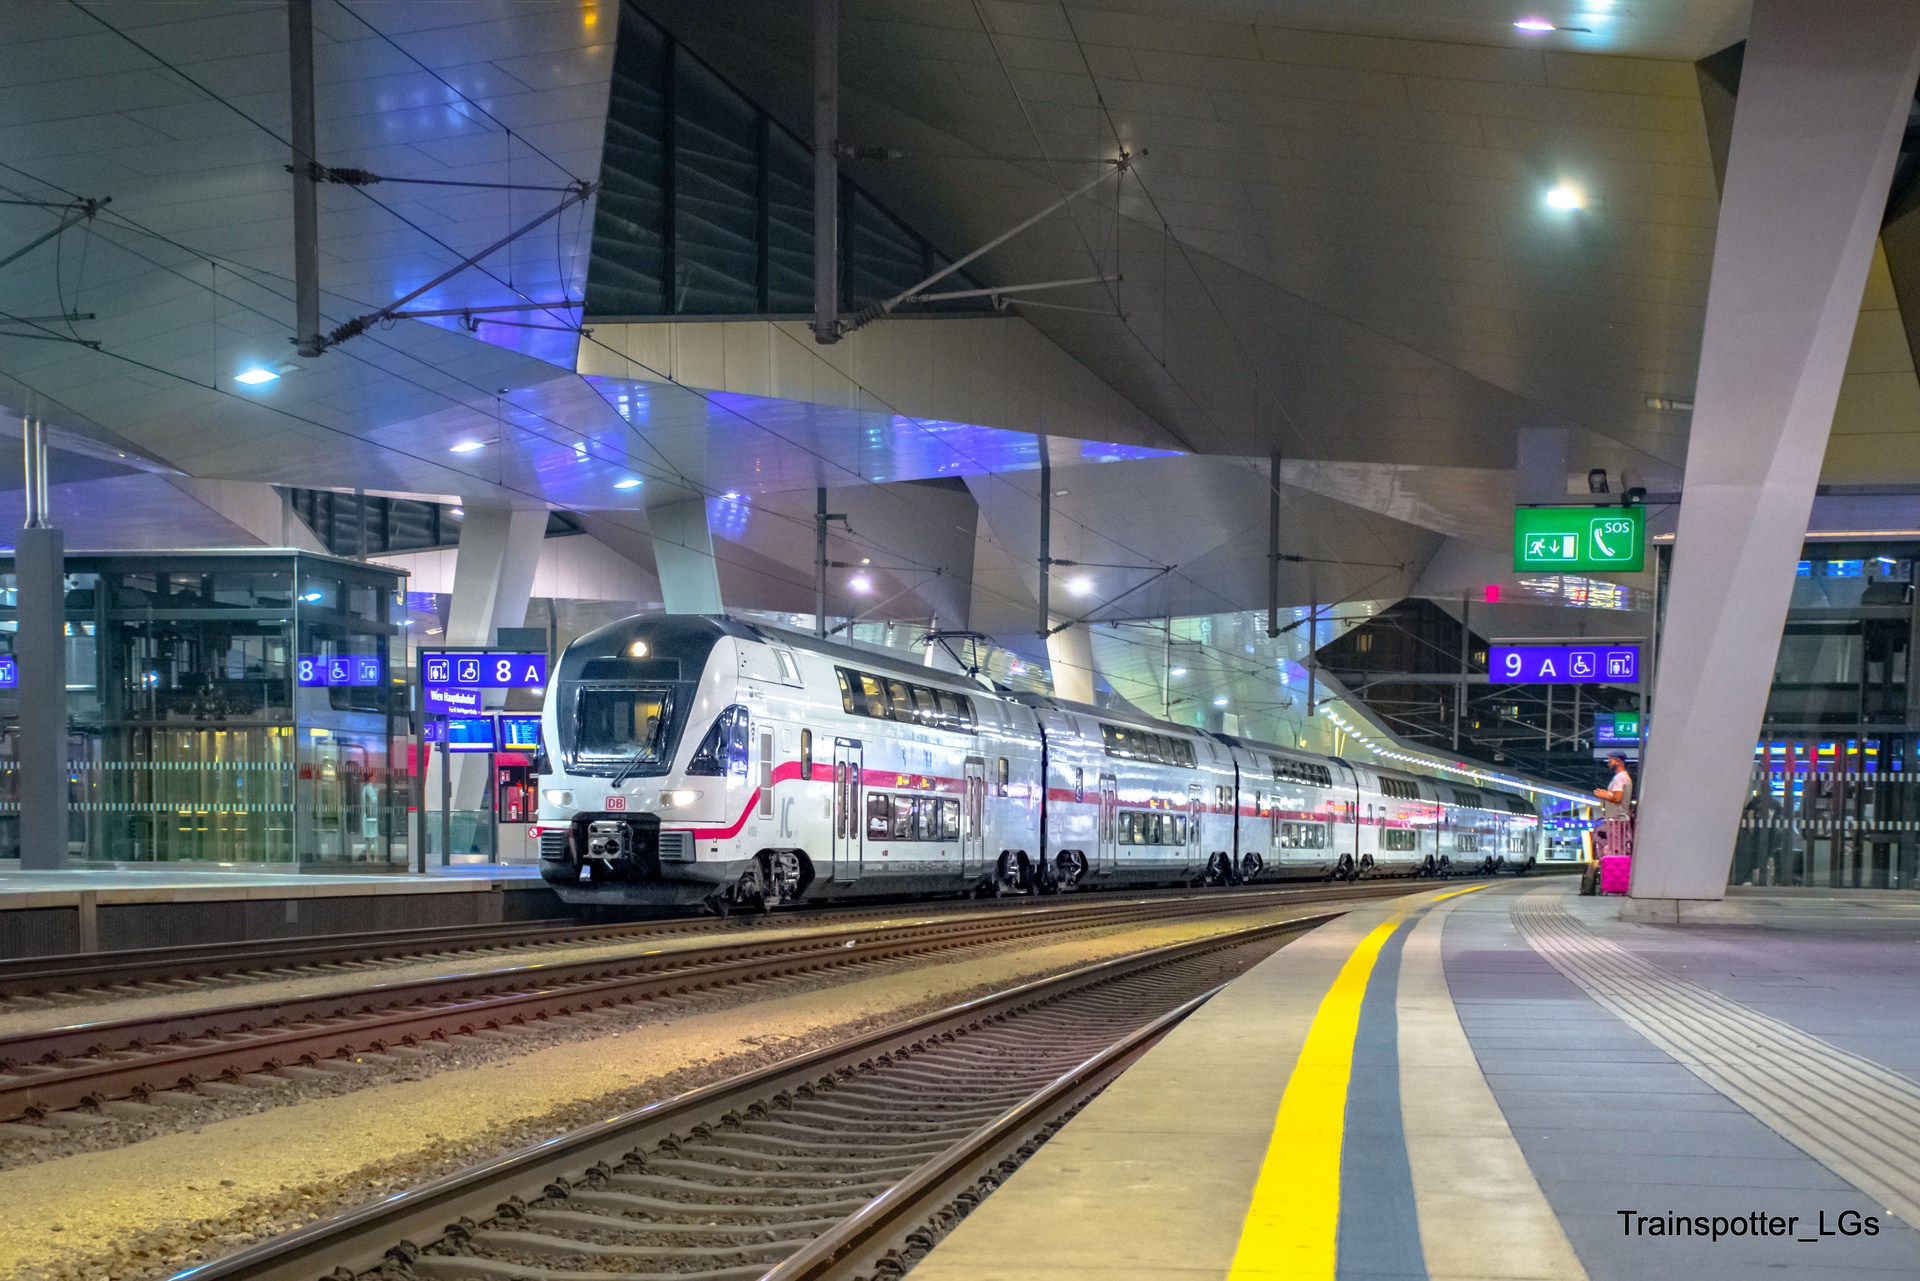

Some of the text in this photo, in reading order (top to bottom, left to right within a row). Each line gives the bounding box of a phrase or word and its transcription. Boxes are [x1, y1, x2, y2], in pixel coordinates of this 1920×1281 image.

[1604, 522, 1630, 534] SOS
[298, 660, 314, 682] 8
[496, 660, 540, 682] 8 A
[1505, 653, 1557, 678] 9 A
[608, 798, 623, 809] DB
[779, 796, 795, 839] IC
